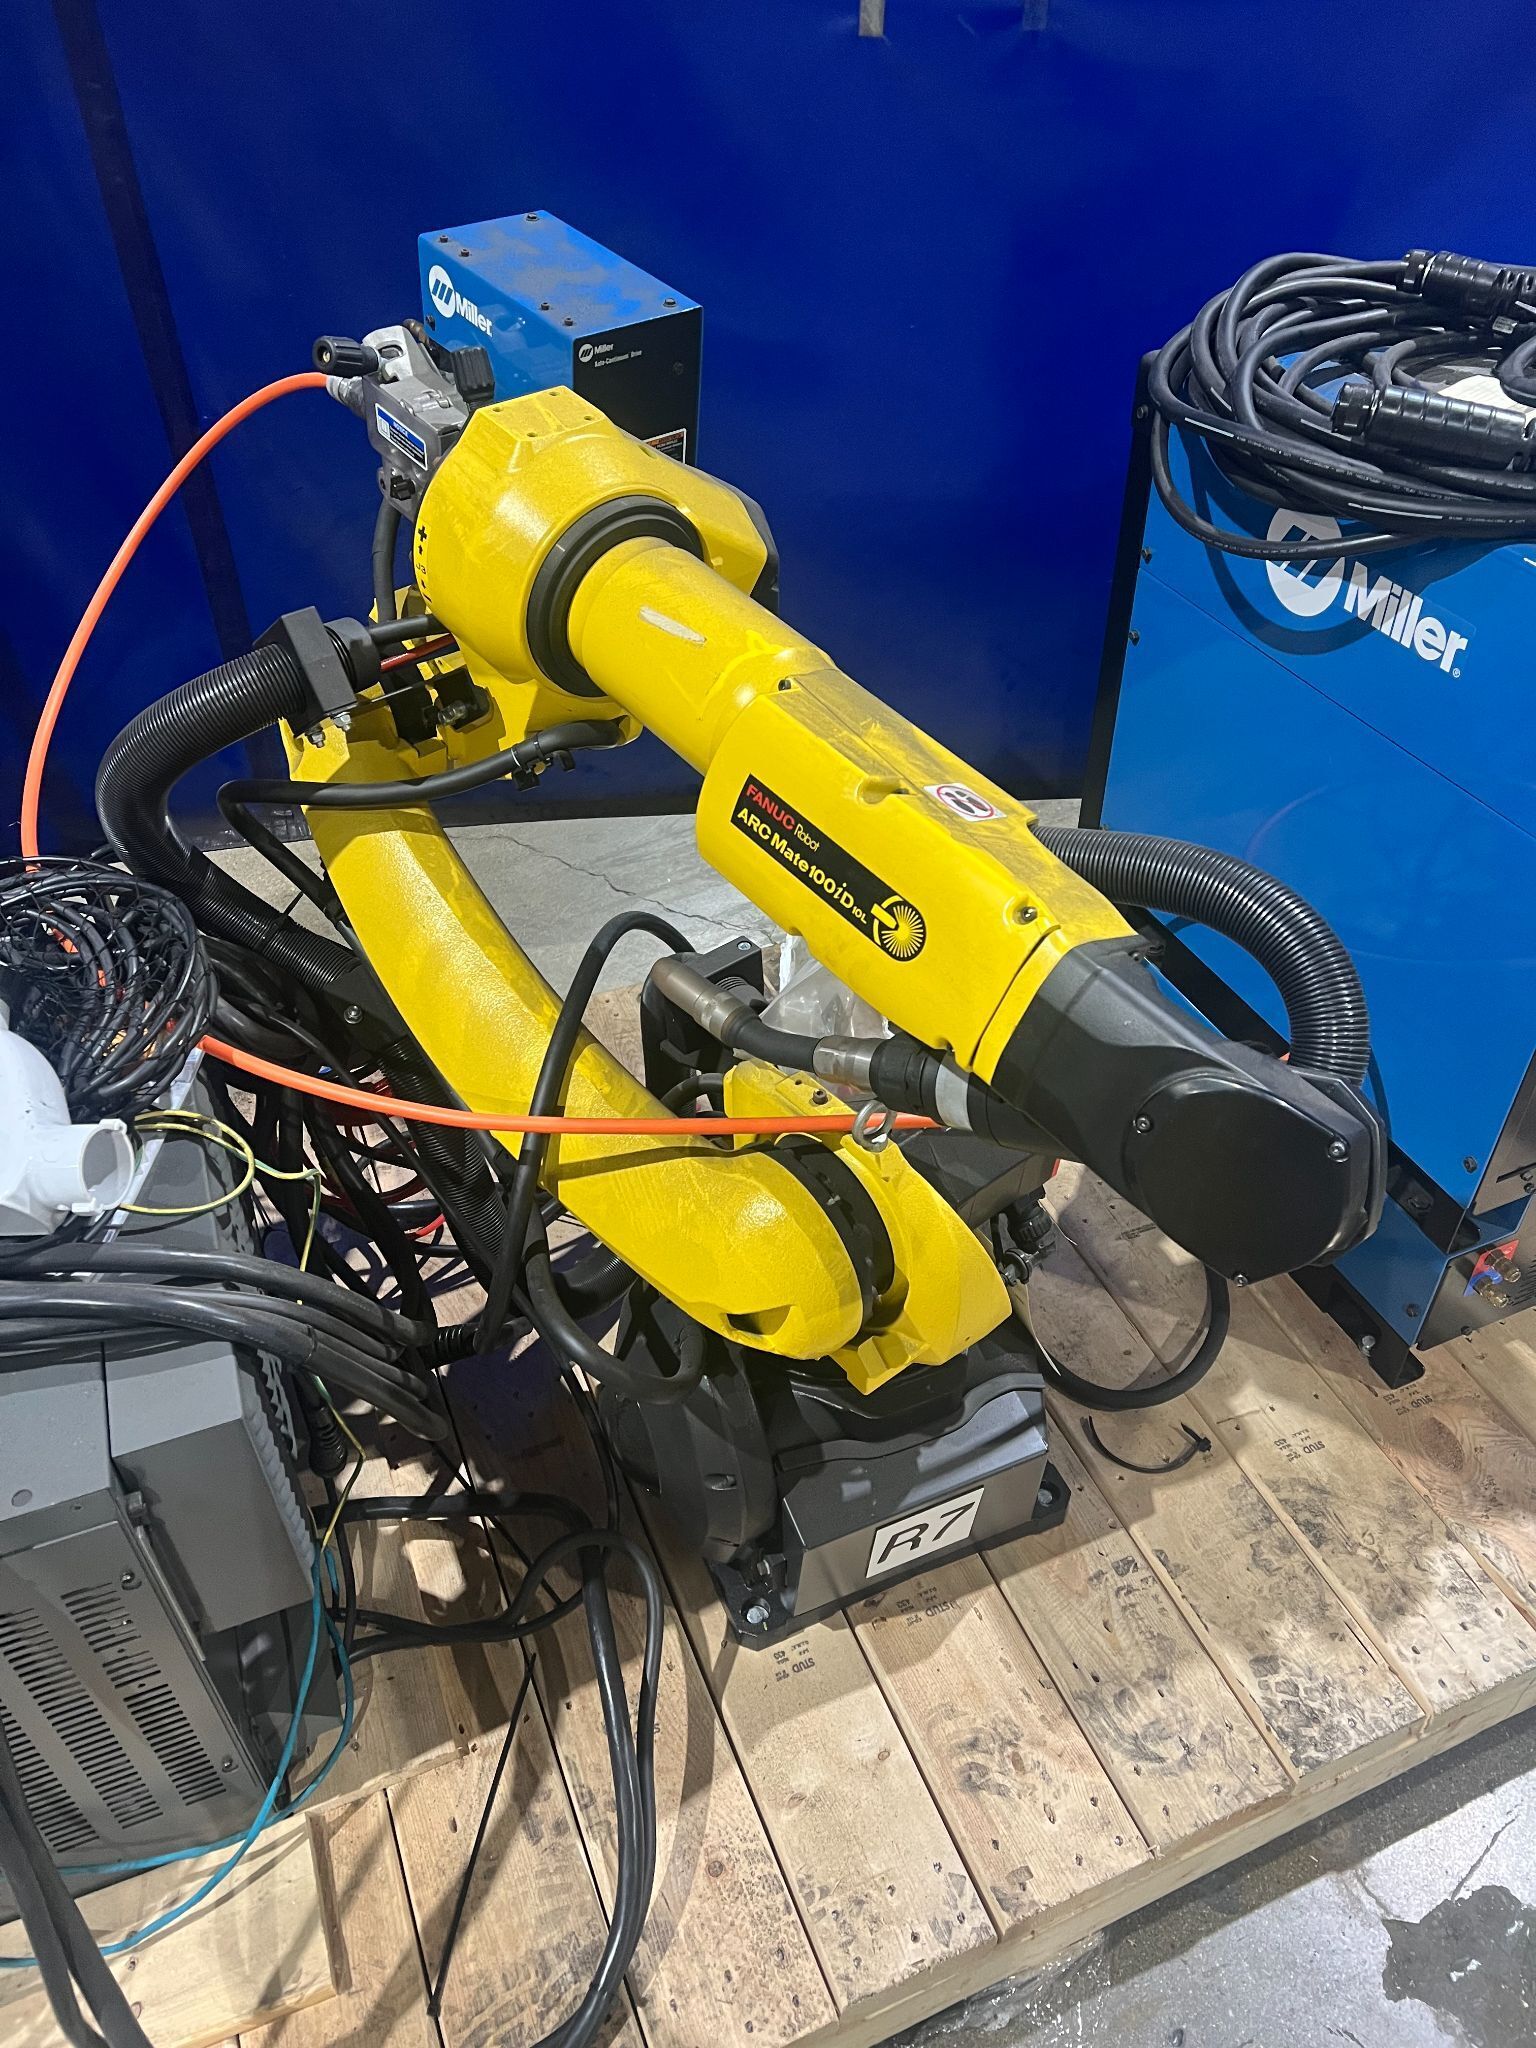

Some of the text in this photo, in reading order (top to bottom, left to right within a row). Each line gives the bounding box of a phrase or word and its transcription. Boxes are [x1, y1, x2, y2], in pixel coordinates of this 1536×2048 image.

[455, 291, 493, 338] Miller
[594, 344, 614, 355] Miller
[1343, 561, 1469, 673] Miller
[737, 807, 772, 840] ARC
[746, 784, 820, 852] FANUC Robot
[1303, 1441, 1326, 1454] STUD
[877, 1501, 976, 1565] R7
[792, 1658, 816, 1673] STUD
